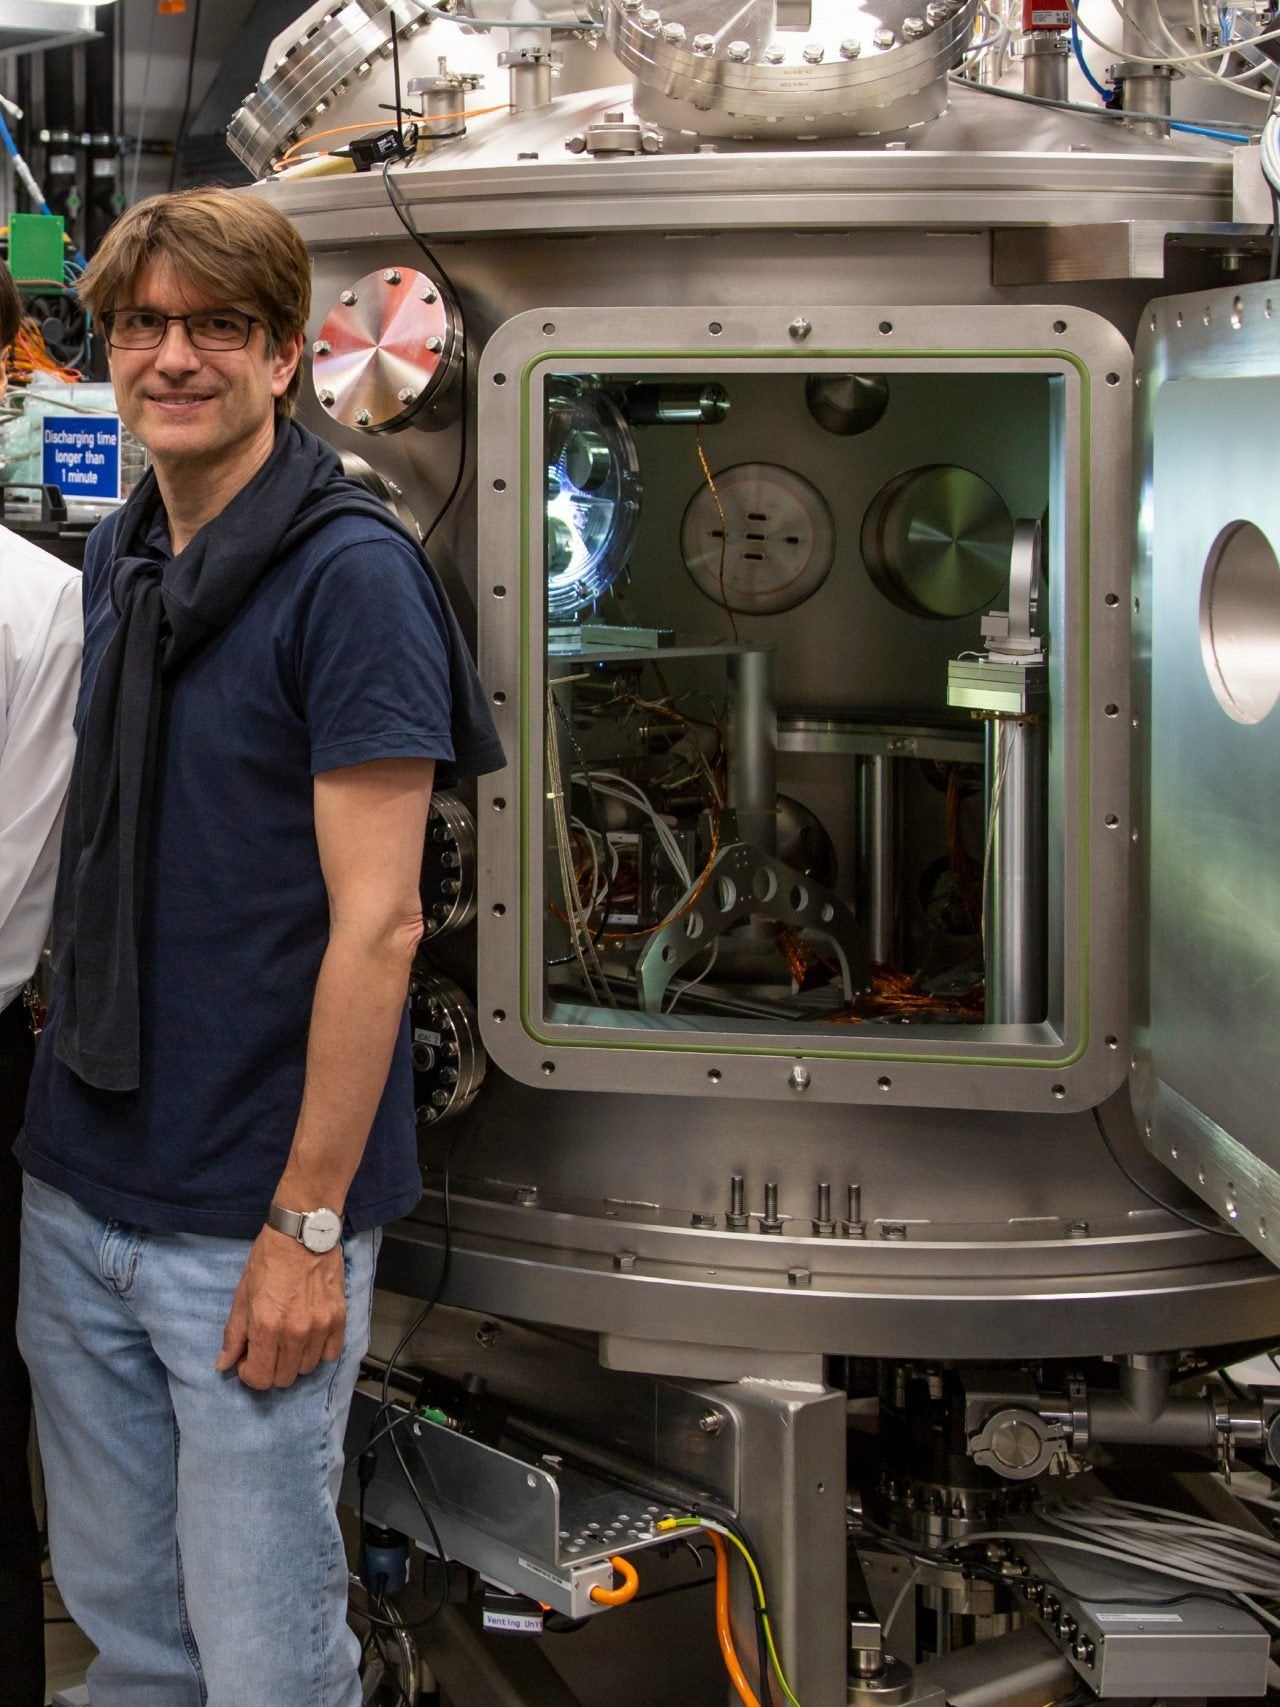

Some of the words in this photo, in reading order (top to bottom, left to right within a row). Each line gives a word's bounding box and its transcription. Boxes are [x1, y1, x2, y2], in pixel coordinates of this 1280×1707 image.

[44, 429, 94, 448] Discharging
[97, 431, 117, 446] time
[55, 448, 83, 467] longer
[85, 450, 105, 464] than
[61, 468, 66, 482] 1
[68, 469, 98, 484] minute
[487, 1615, 521, 1628] Venting
